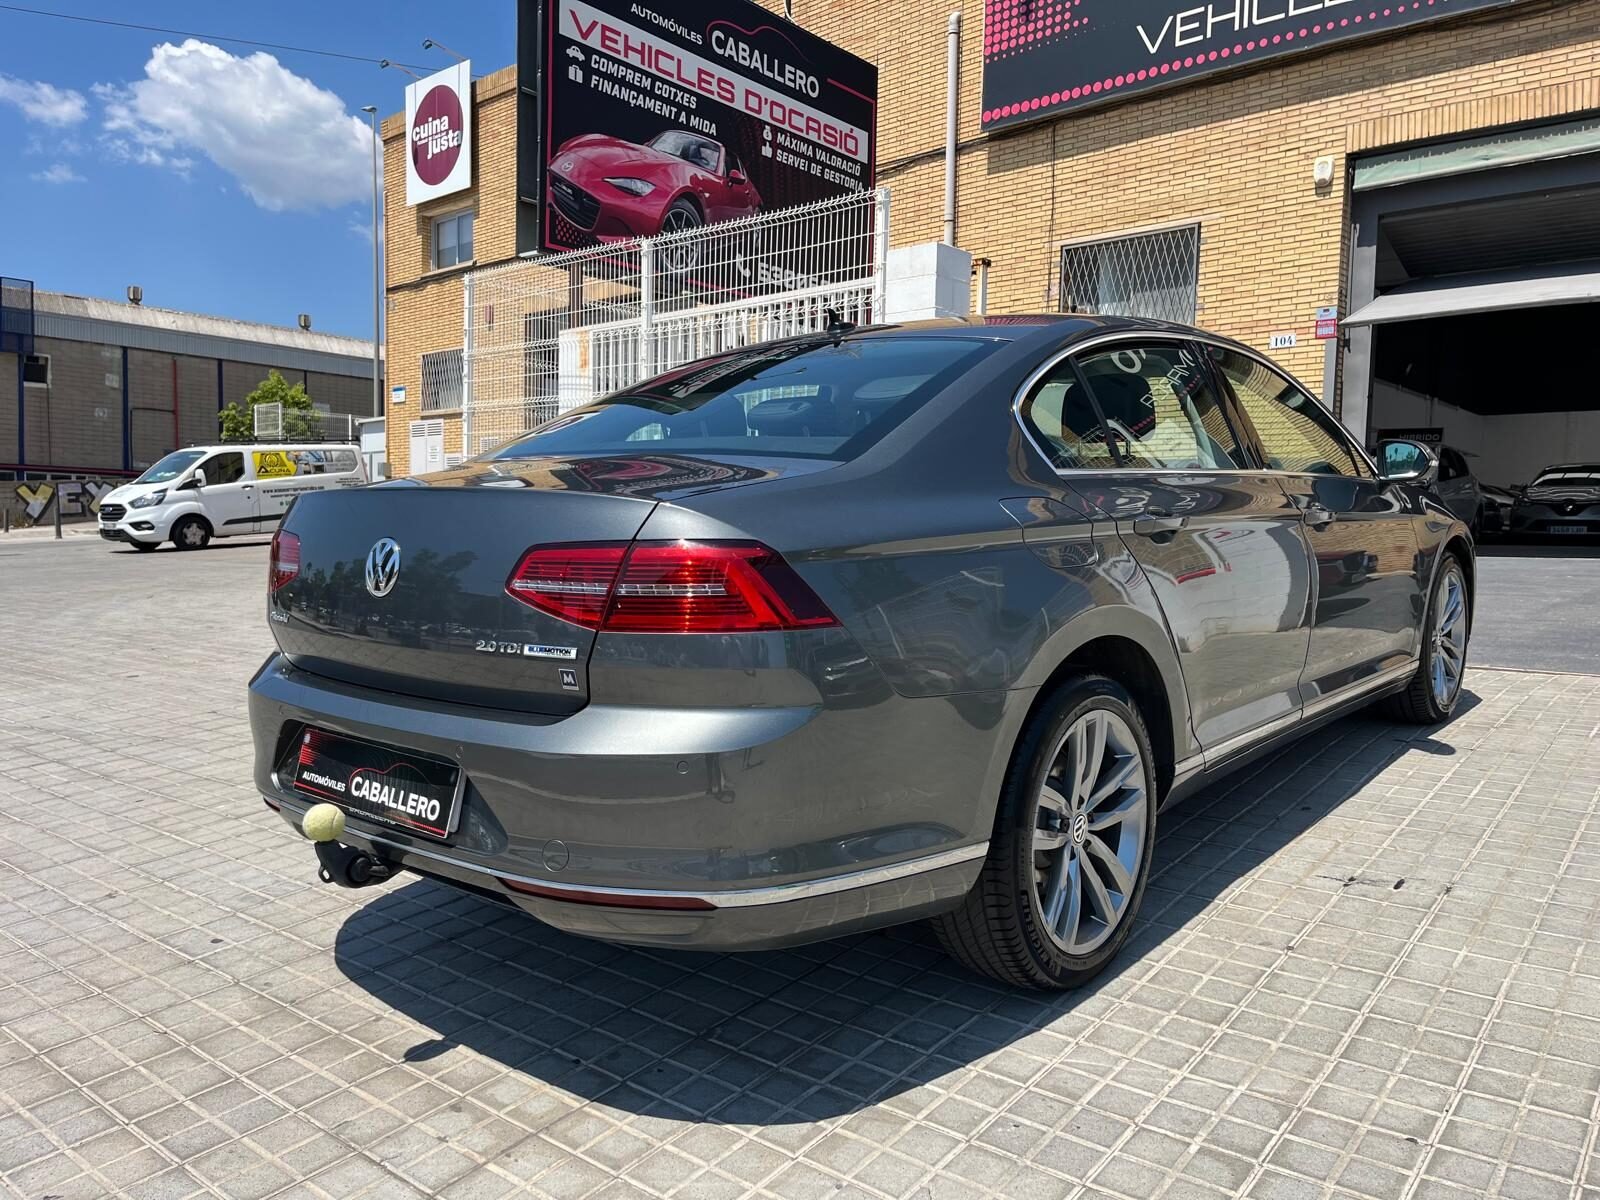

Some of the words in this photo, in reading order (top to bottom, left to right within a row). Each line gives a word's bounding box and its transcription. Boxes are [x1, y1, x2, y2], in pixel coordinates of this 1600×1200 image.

[1136, 0, 1353, 54] VEHICL
[630, 3, 703, 45] AUTOMÓVILES
[711, 30, 820, 98] CABALLERO
[569, 8, 736, 103] VEHICLES
[744, 88, 859, 157] D'OCASIÓ
[591, 54, 652, 91] COMPREM
[654, 81, 698, 109] COTXES
[590, 75, 678, 119] FINANÇAMENT
[679, 111, 687, 125] A
[690, 115, 717, 136] MIDA
[412, 116, 449, 142] cuina
[427, 130, 462, 159] justa
[776, 149, 808, 170] SERVEI
[810, 163, 822, 177] DE
[824, 168, 863, 191] GESTORIA
[777, 132, 813, 158] MÀXIMA
[815, 150, 861, 176] VALORACIÓ
[1275, 335, 1293, 347] 104
[16, 481, 120, 518] YEX
[528, 646, 572, 655] BLUEMOTION
[302, 771, 346, 792] AUTOMÓVILES
[351, 776, 441, 822] CABALLERO
